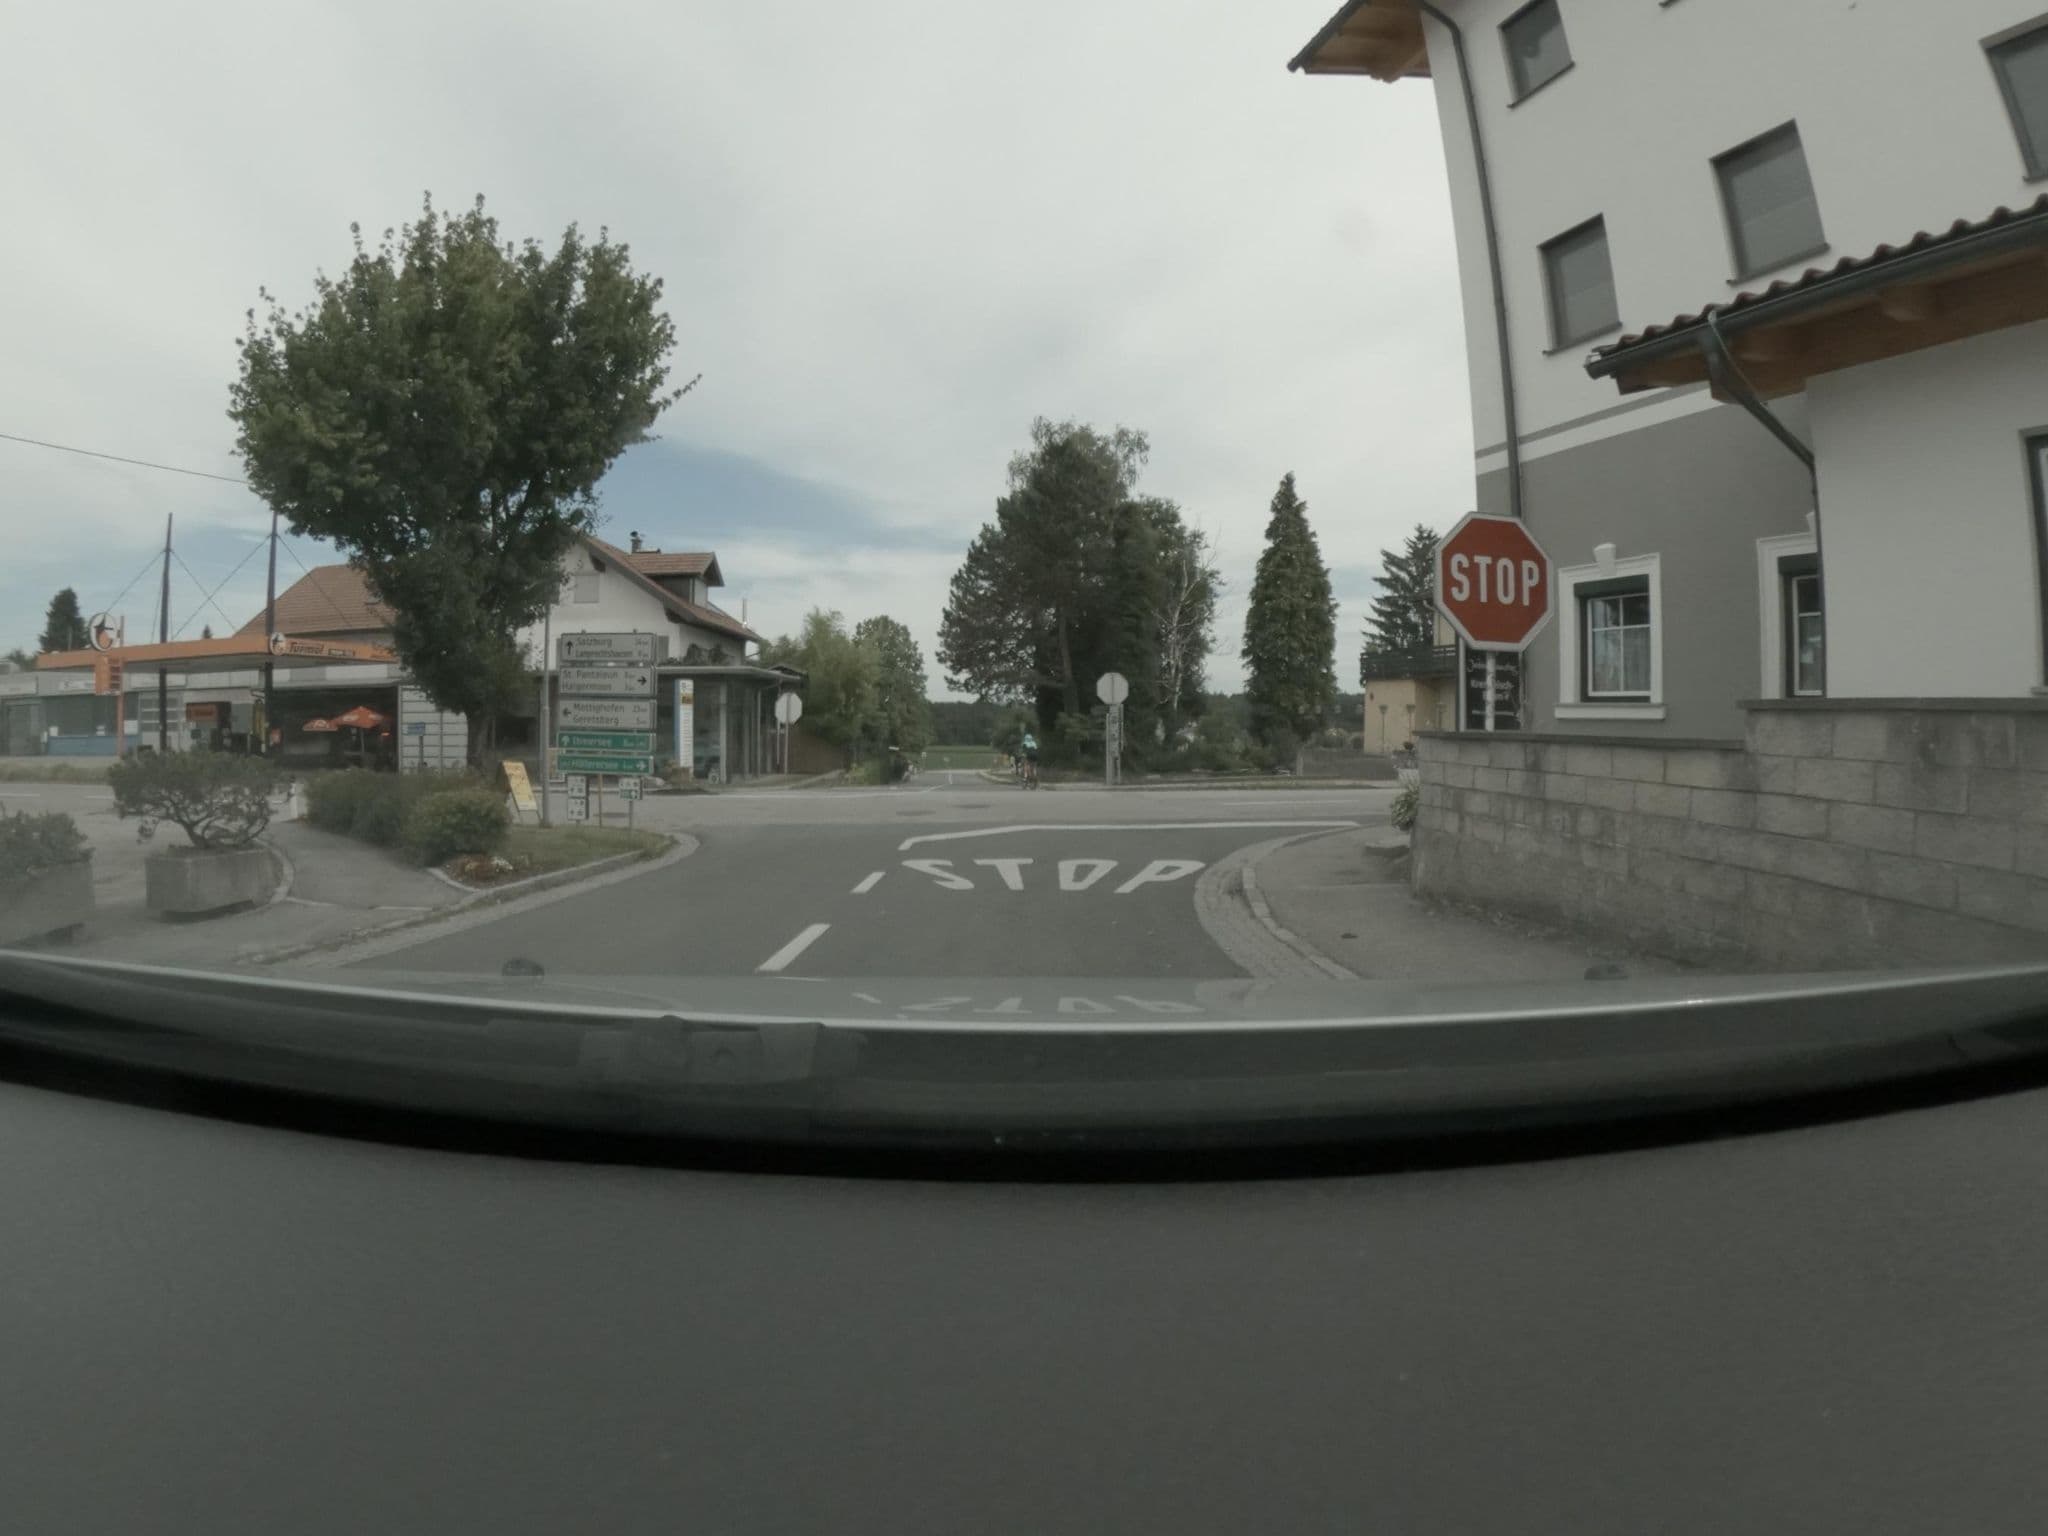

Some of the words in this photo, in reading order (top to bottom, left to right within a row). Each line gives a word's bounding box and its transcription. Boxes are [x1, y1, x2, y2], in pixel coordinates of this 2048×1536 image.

[1450, 552, 1540, 607] STOP
[576, 637, 613, 649] Salzburg
[573, 703, 625, 714] Mattighofen
[899, 858, 1208, 893] STOP
